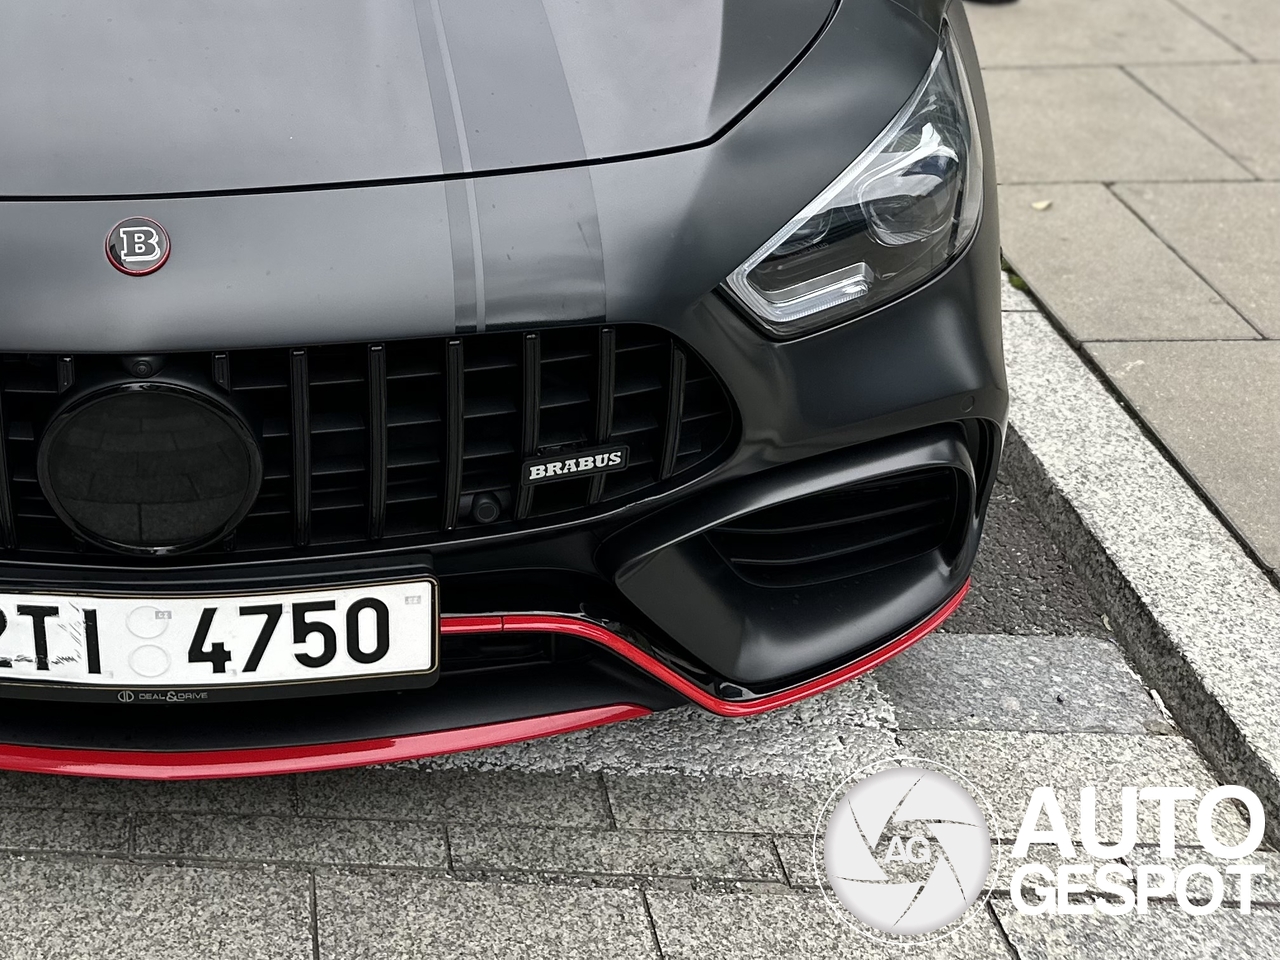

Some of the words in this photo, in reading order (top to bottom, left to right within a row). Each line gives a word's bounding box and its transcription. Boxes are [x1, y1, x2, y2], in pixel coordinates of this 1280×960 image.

[120, 226, 160, 262] B
[529, 451, 622, 480] BRABUS
[188, 597, 390, 674] 4750
